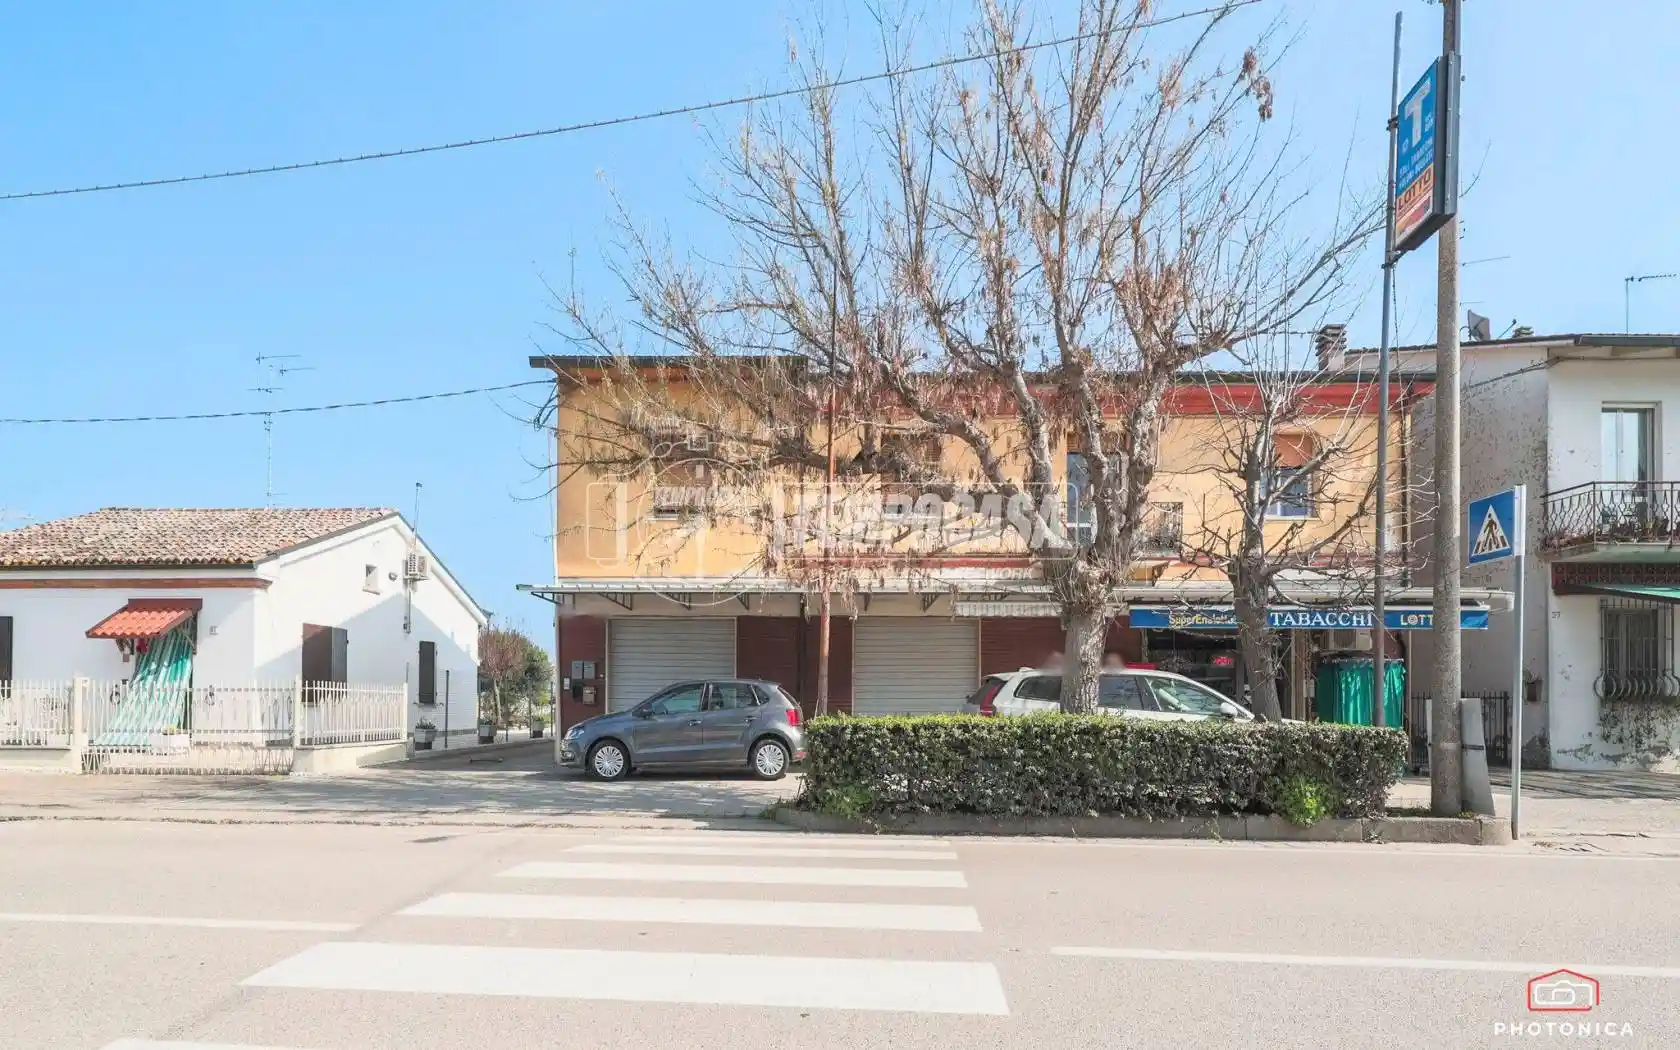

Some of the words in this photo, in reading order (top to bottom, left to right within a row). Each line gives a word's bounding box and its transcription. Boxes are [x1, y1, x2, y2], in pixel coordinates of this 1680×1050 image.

[1404, 75, 1431, 149] T
[1397, 166, 1432, 211] LOTTO
[1270, 612, 1373, 627] TABACCHI
[1400, 614, 1434, 626] LOTT
